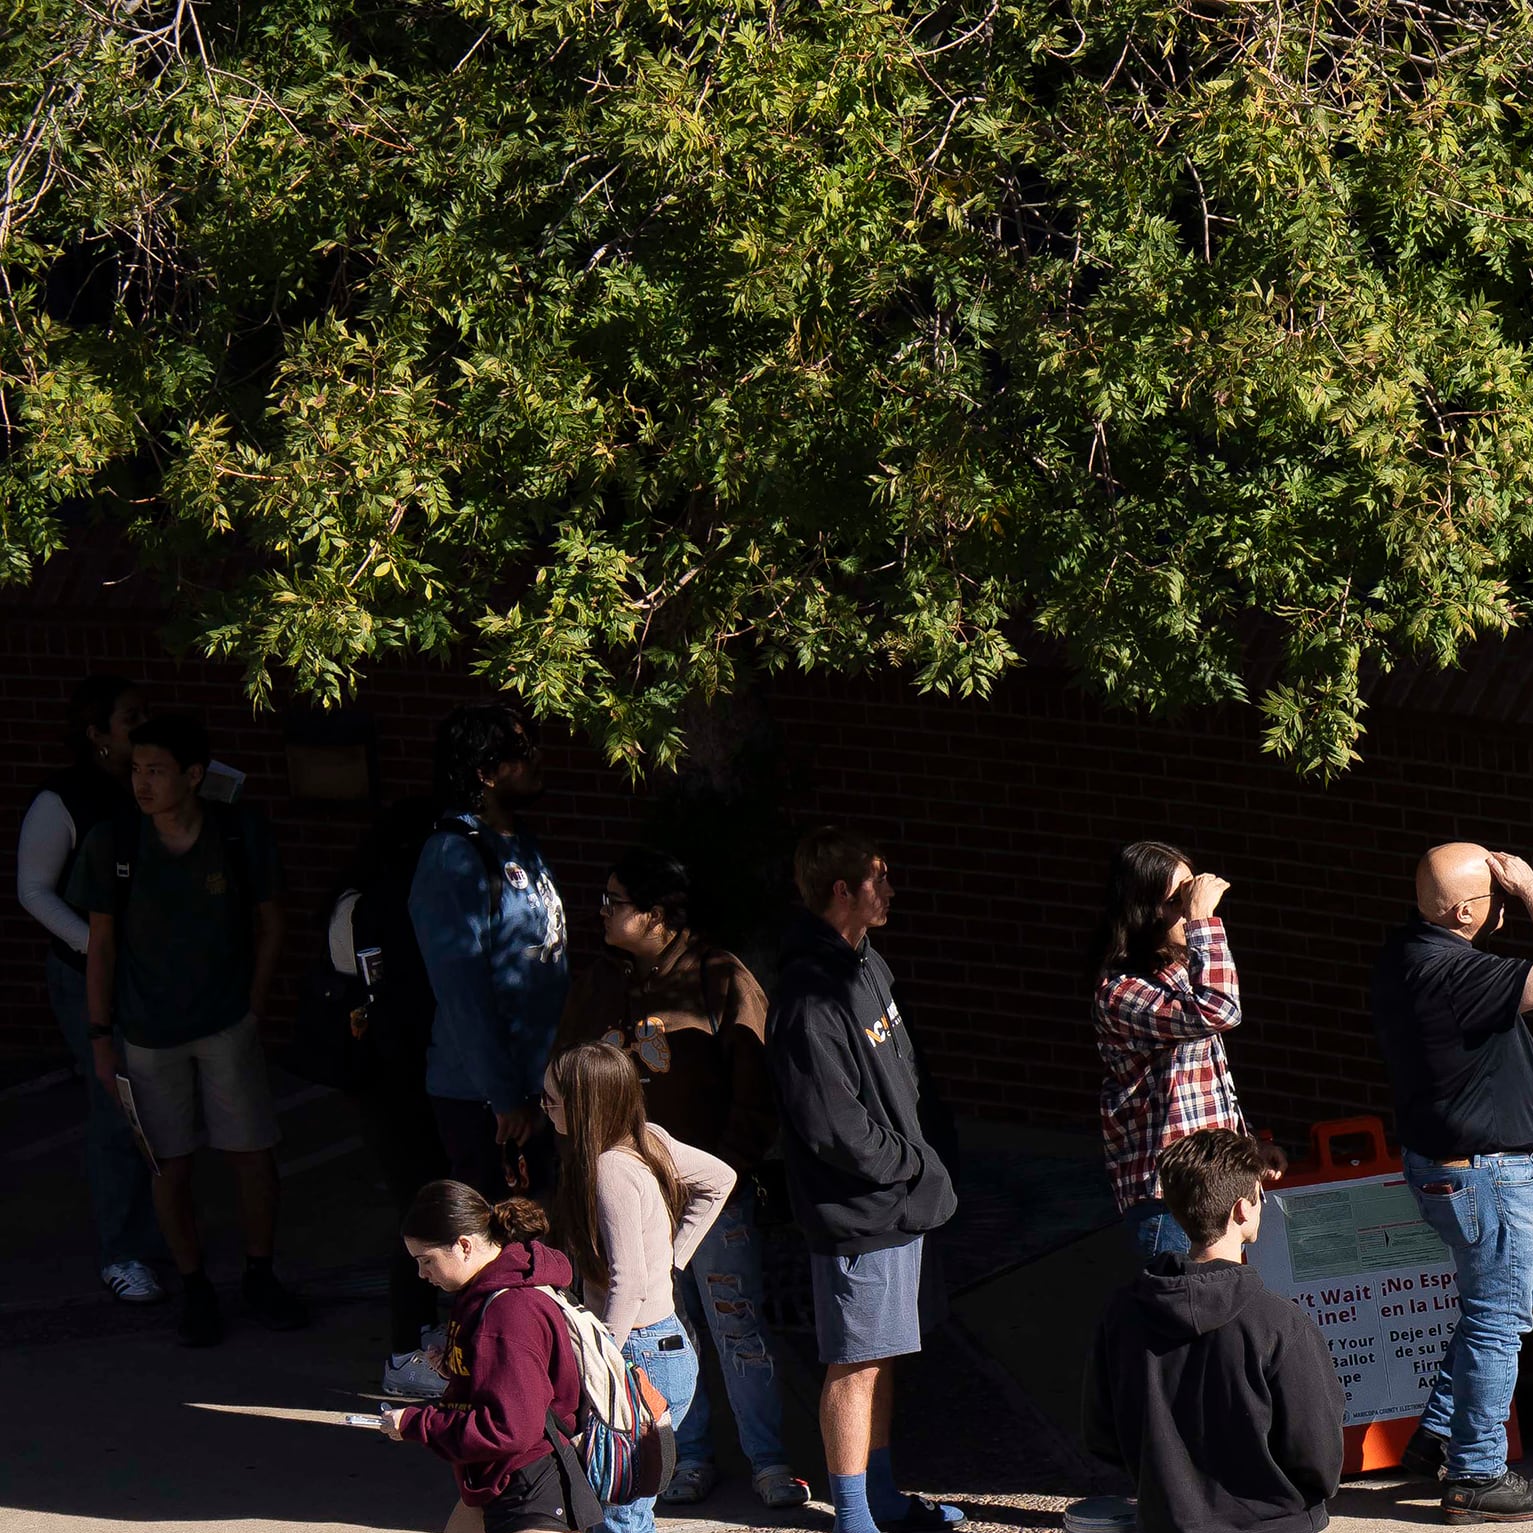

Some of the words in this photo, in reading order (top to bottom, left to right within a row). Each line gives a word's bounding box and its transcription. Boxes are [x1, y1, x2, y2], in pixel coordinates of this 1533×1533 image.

[1320, 1284, 1372, 1305] Wait
[1307, 1306, 1357, 1326] ine!
[1381, 1303, 1404, 1318] en
[1410, 1299, 1427, 1314] la
[1389, 1327, 1424, 1343] Deje
[1428, 1323, 1442, 1337] el
[1446, 1322, 1455, 1335] S
[1338, 1336, 1375, 1351] Your
[1395, 1346, 1414, 1358] de
[1418, 1344, 1435, 1356] su
[1440, 1340, 1449, 1352] B
[1418, 1375, 1439, 1389] Ad
